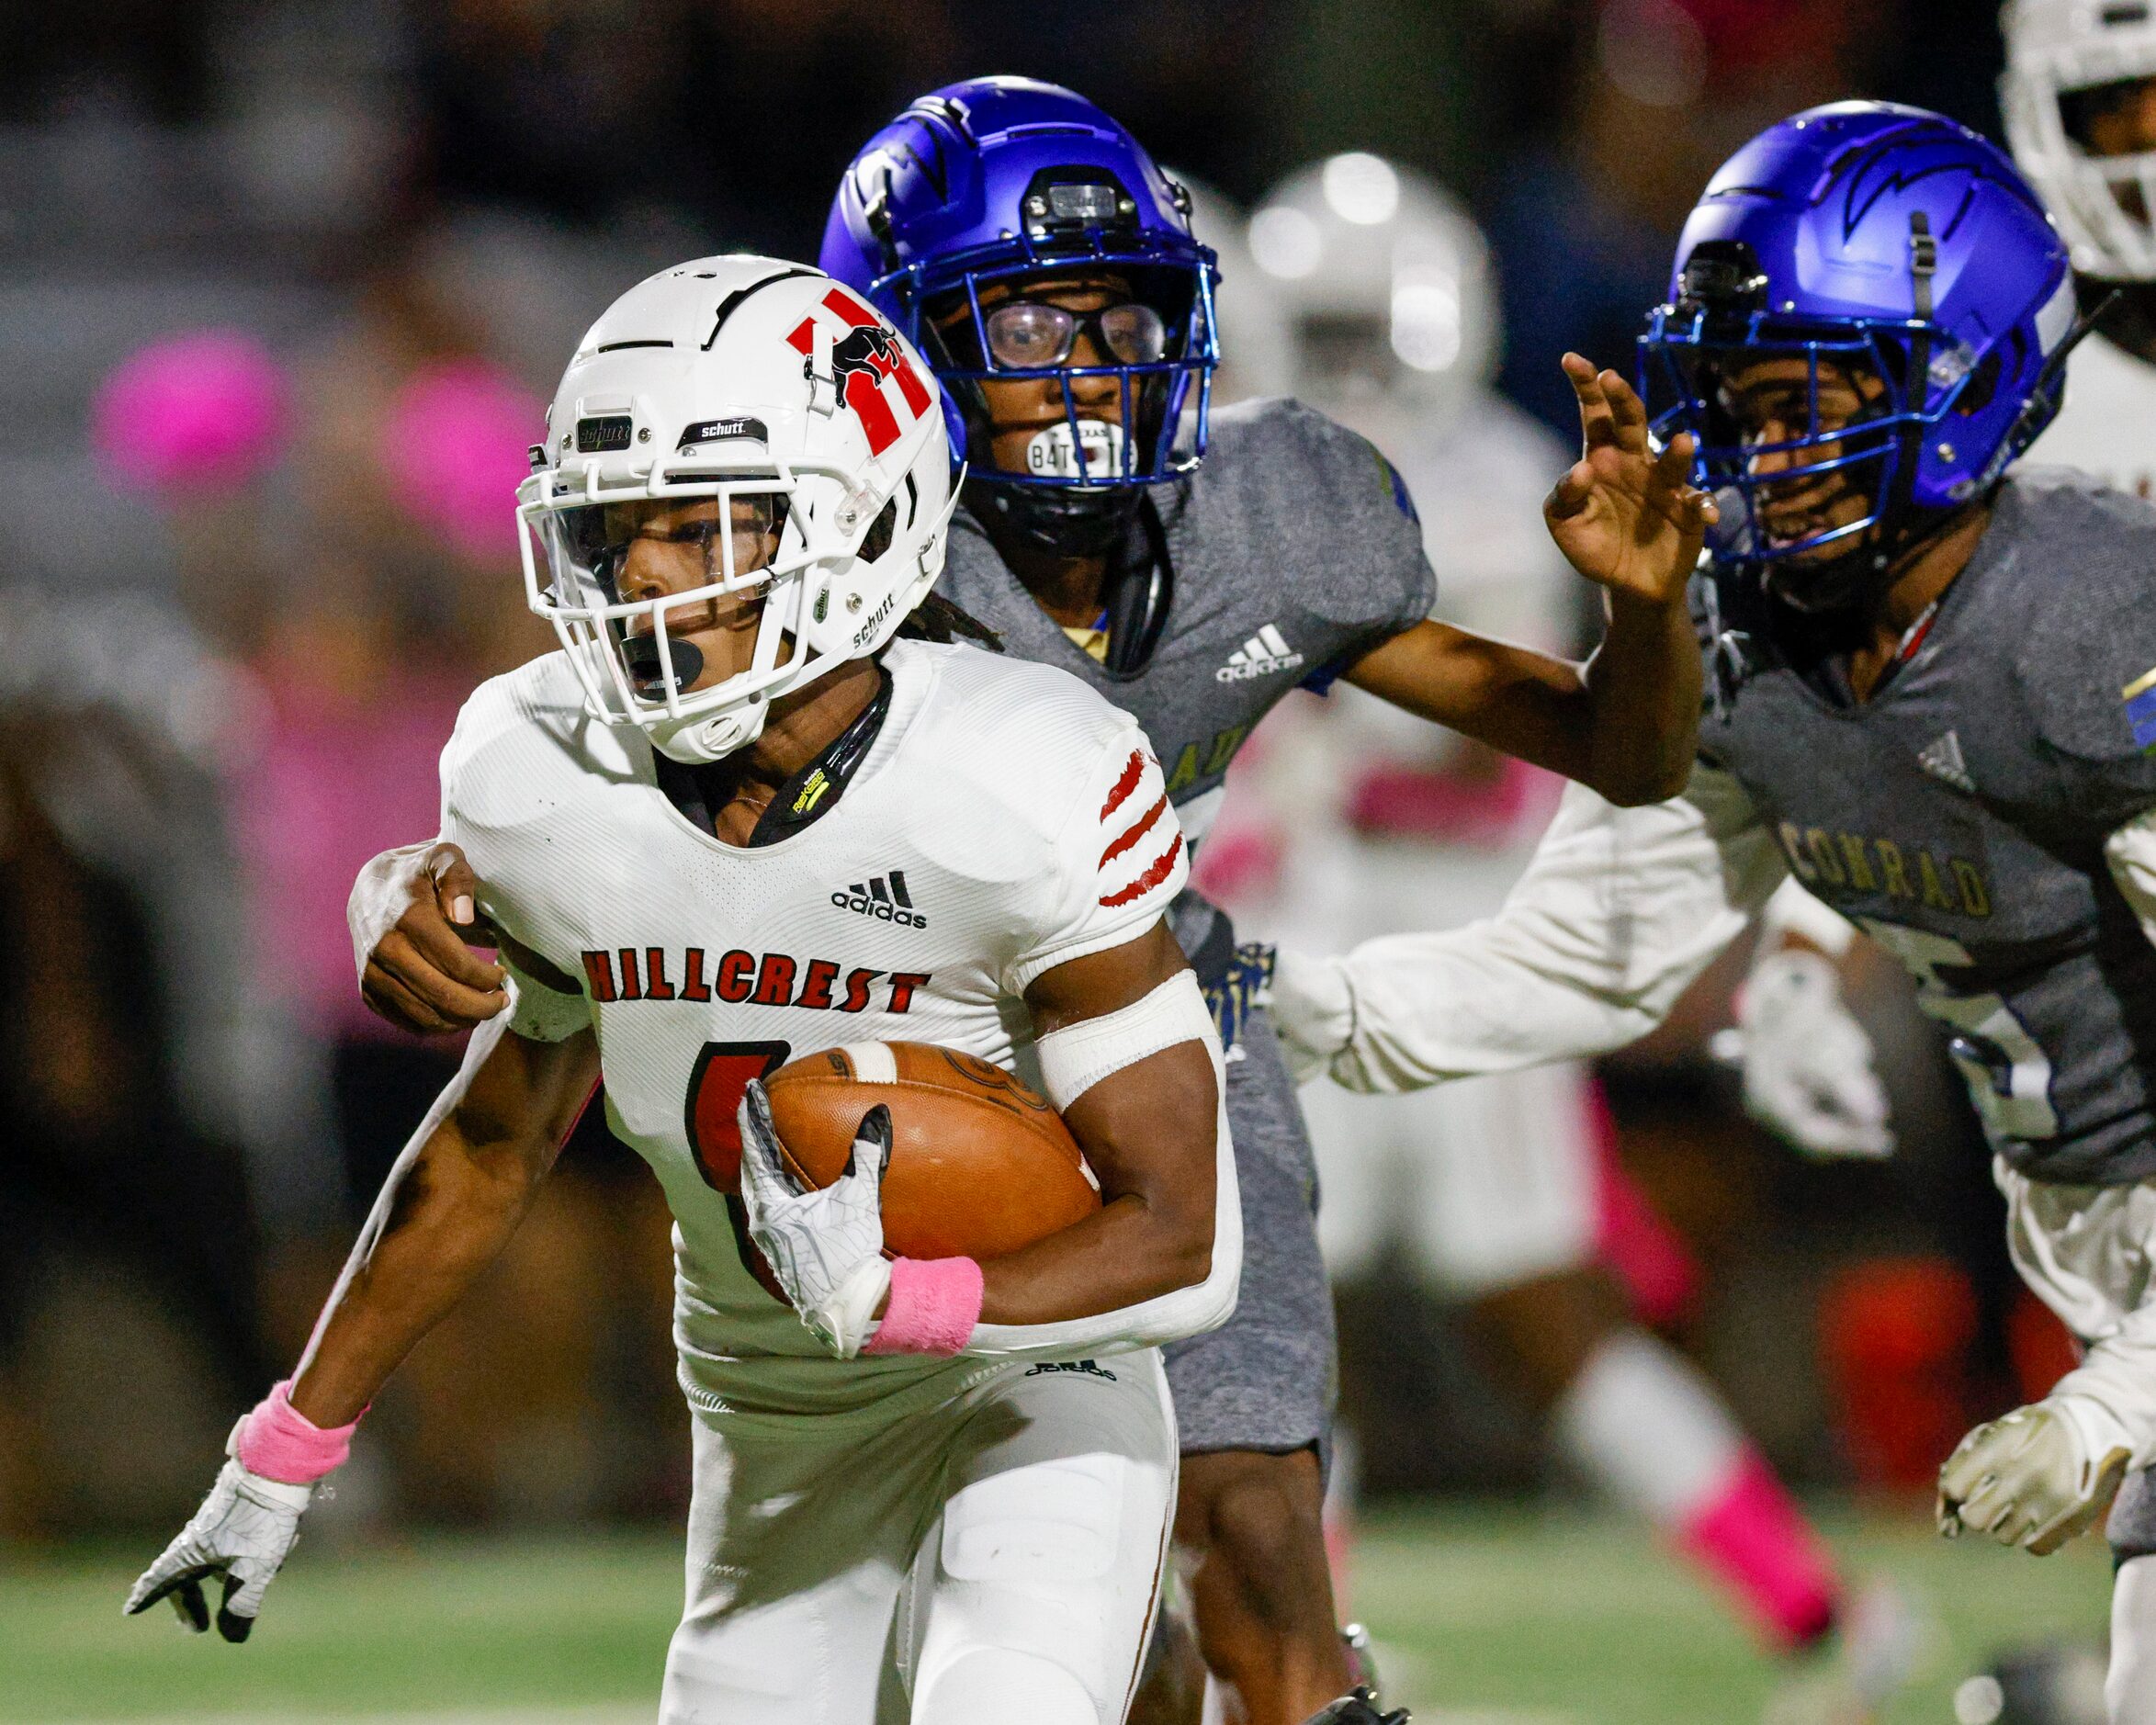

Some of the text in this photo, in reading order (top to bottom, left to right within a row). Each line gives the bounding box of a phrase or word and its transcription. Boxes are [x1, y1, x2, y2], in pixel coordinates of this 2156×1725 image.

[701, 422, 744, 438] schutt
[852, 593, 895, 649] schutt
[830, 892, 928, 930] adidas
[581, 947, 932, 1014] HILLCREST
